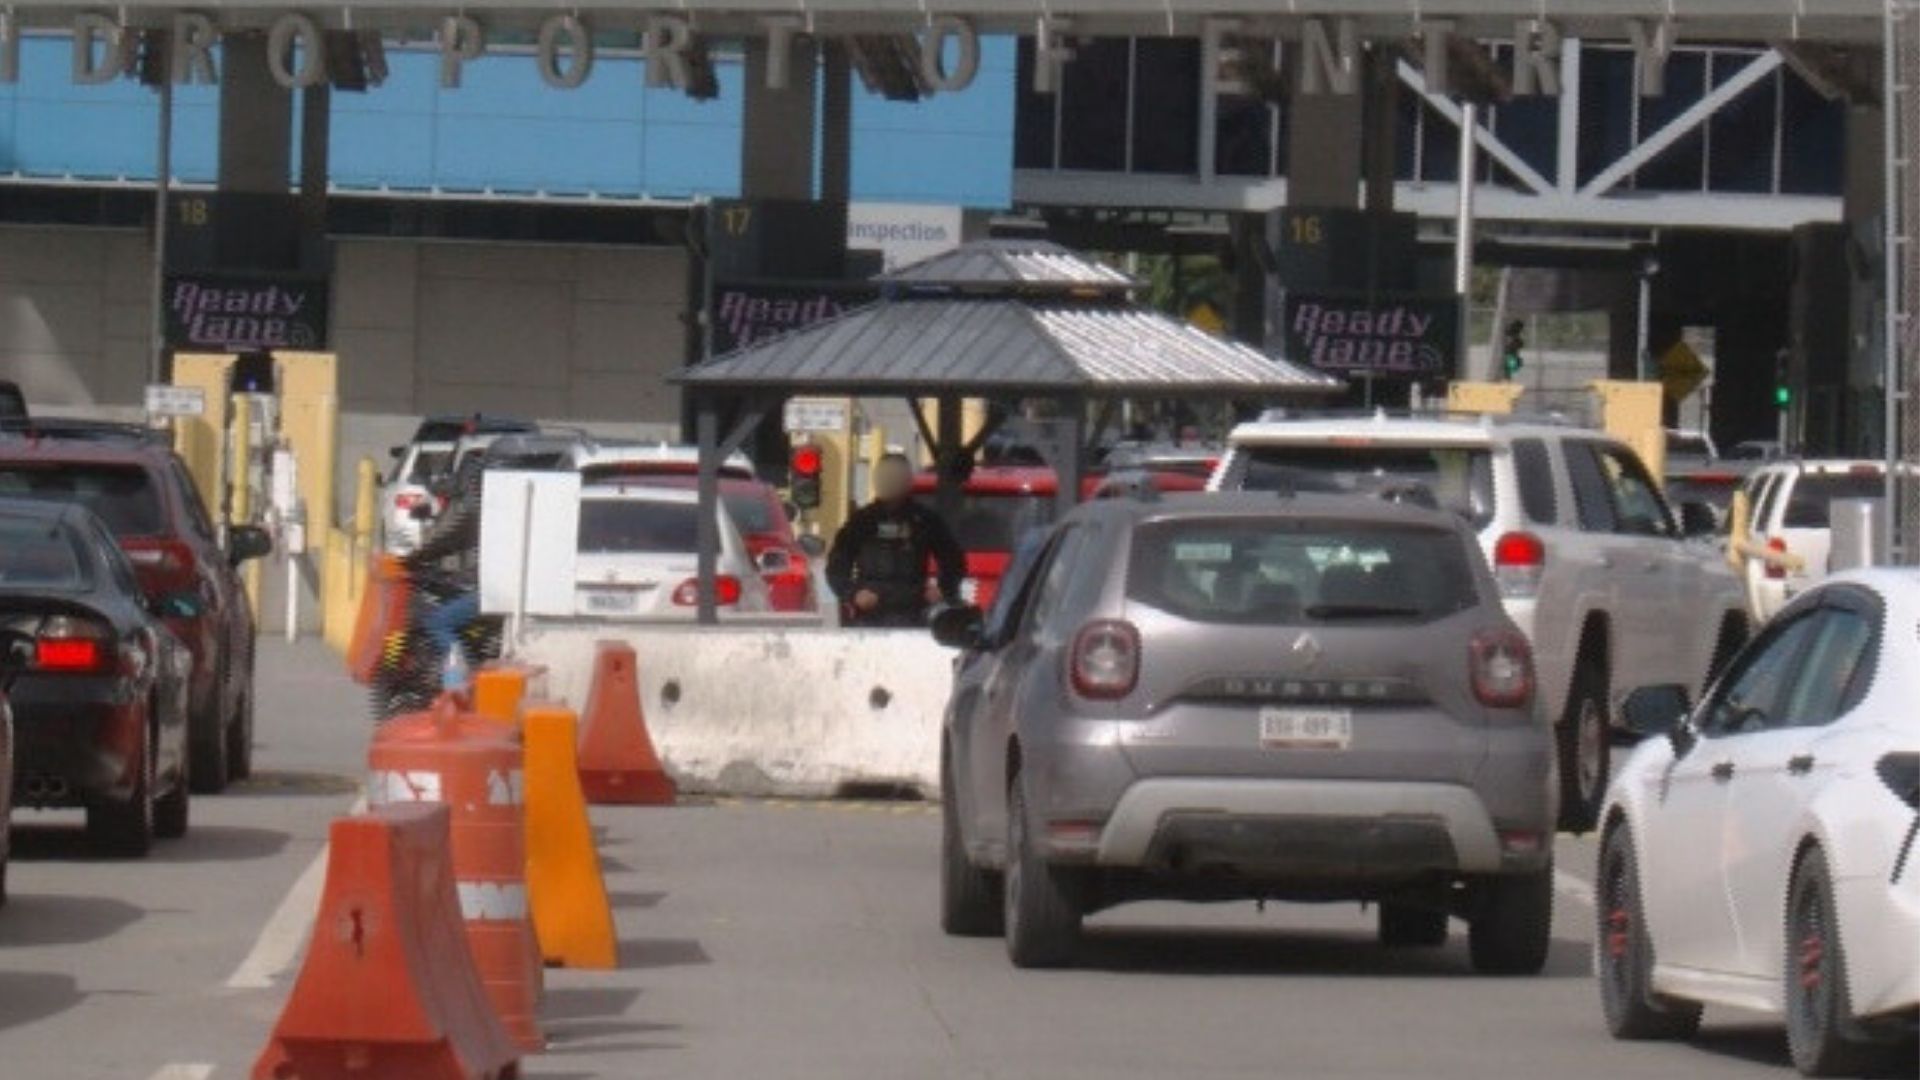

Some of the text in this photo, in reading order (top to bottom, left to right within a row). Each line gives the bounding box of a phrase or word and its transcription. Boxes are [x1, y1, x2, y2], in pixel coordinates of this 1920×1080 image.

[440, 16, 803, 90] PORT
[920, 17, 1078, 92] OF
[1203, 17, 1677, 97] ENTRY
[181, 200, 207, 225] 18
[725, 208, 750, 236] 17
[1292, 216, 1321, 243] 16
[173, 281, 306, 324] Ready
[1294, 303, 1432, 346] Ready
